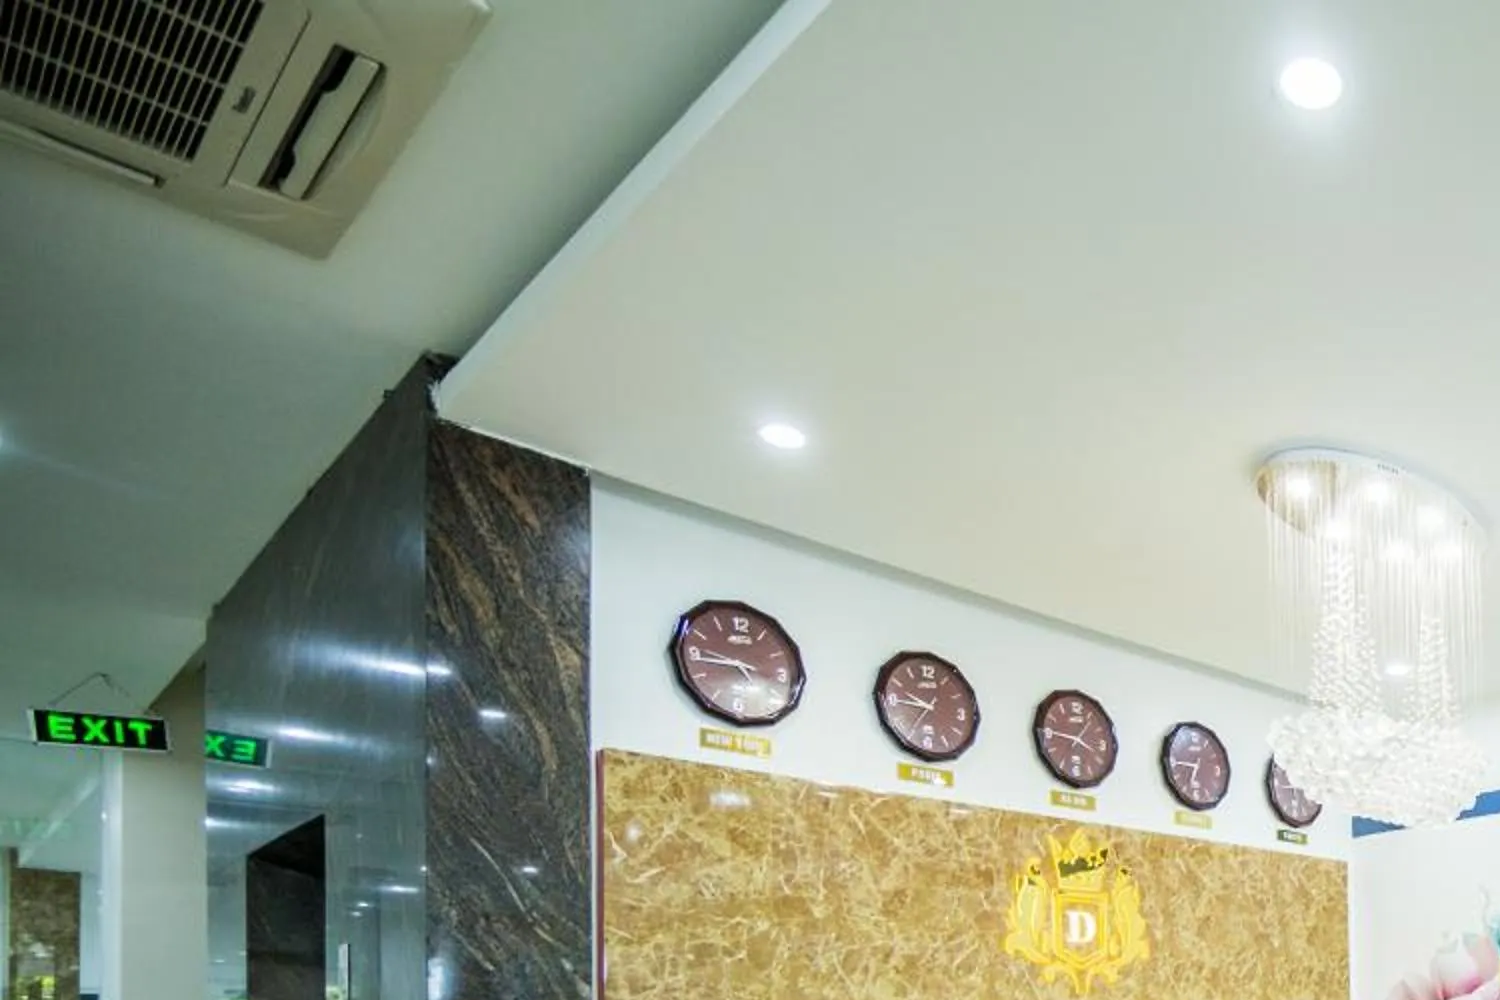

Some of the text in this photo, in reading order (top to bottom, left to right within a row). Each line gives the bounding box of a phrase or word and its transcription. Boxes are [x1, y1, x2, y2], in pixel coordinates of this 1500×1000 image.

[732, 616, 749, 632] 12
[689, 647, 701, 660] 9
[777, 668, 787, 683] 3
[921, 665, 935, 679] 12
[47, 715, 153, 746] EXIT
[1065, 910, 1097, 944] D
